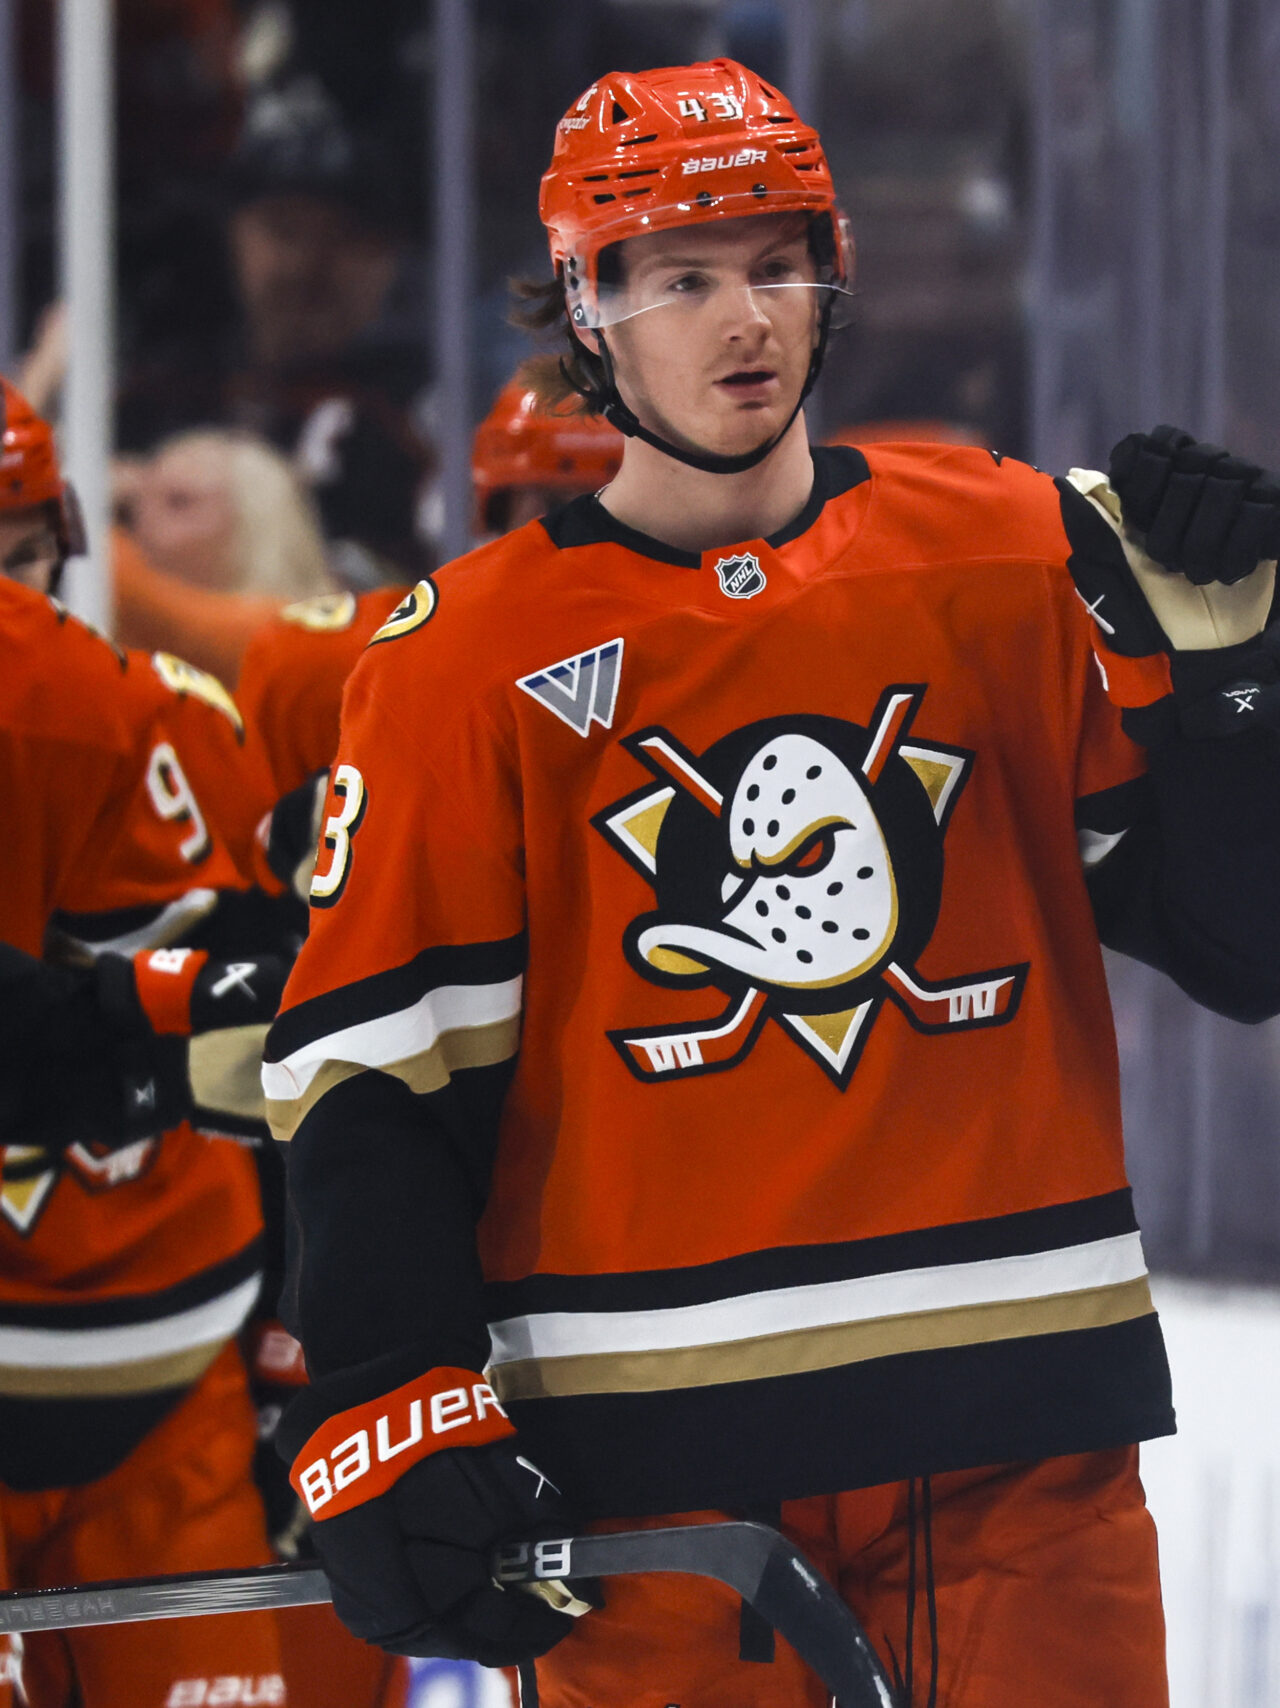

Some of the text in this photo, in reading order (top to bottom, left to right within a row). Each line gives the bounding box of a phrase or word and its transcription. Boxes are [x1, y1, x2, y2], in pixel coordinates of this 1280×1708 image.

[677, 93, 742, 122] 43
[681, 149, 768, 176] BAUER
[730, 565, 753, 592] NHL
[145, 742, 213, 865] 9
[309, 764, 369, 909] 3
[300, 1383, 509, 1513] BAUER
[0, 1597, 116, 1625] HYPERLI
